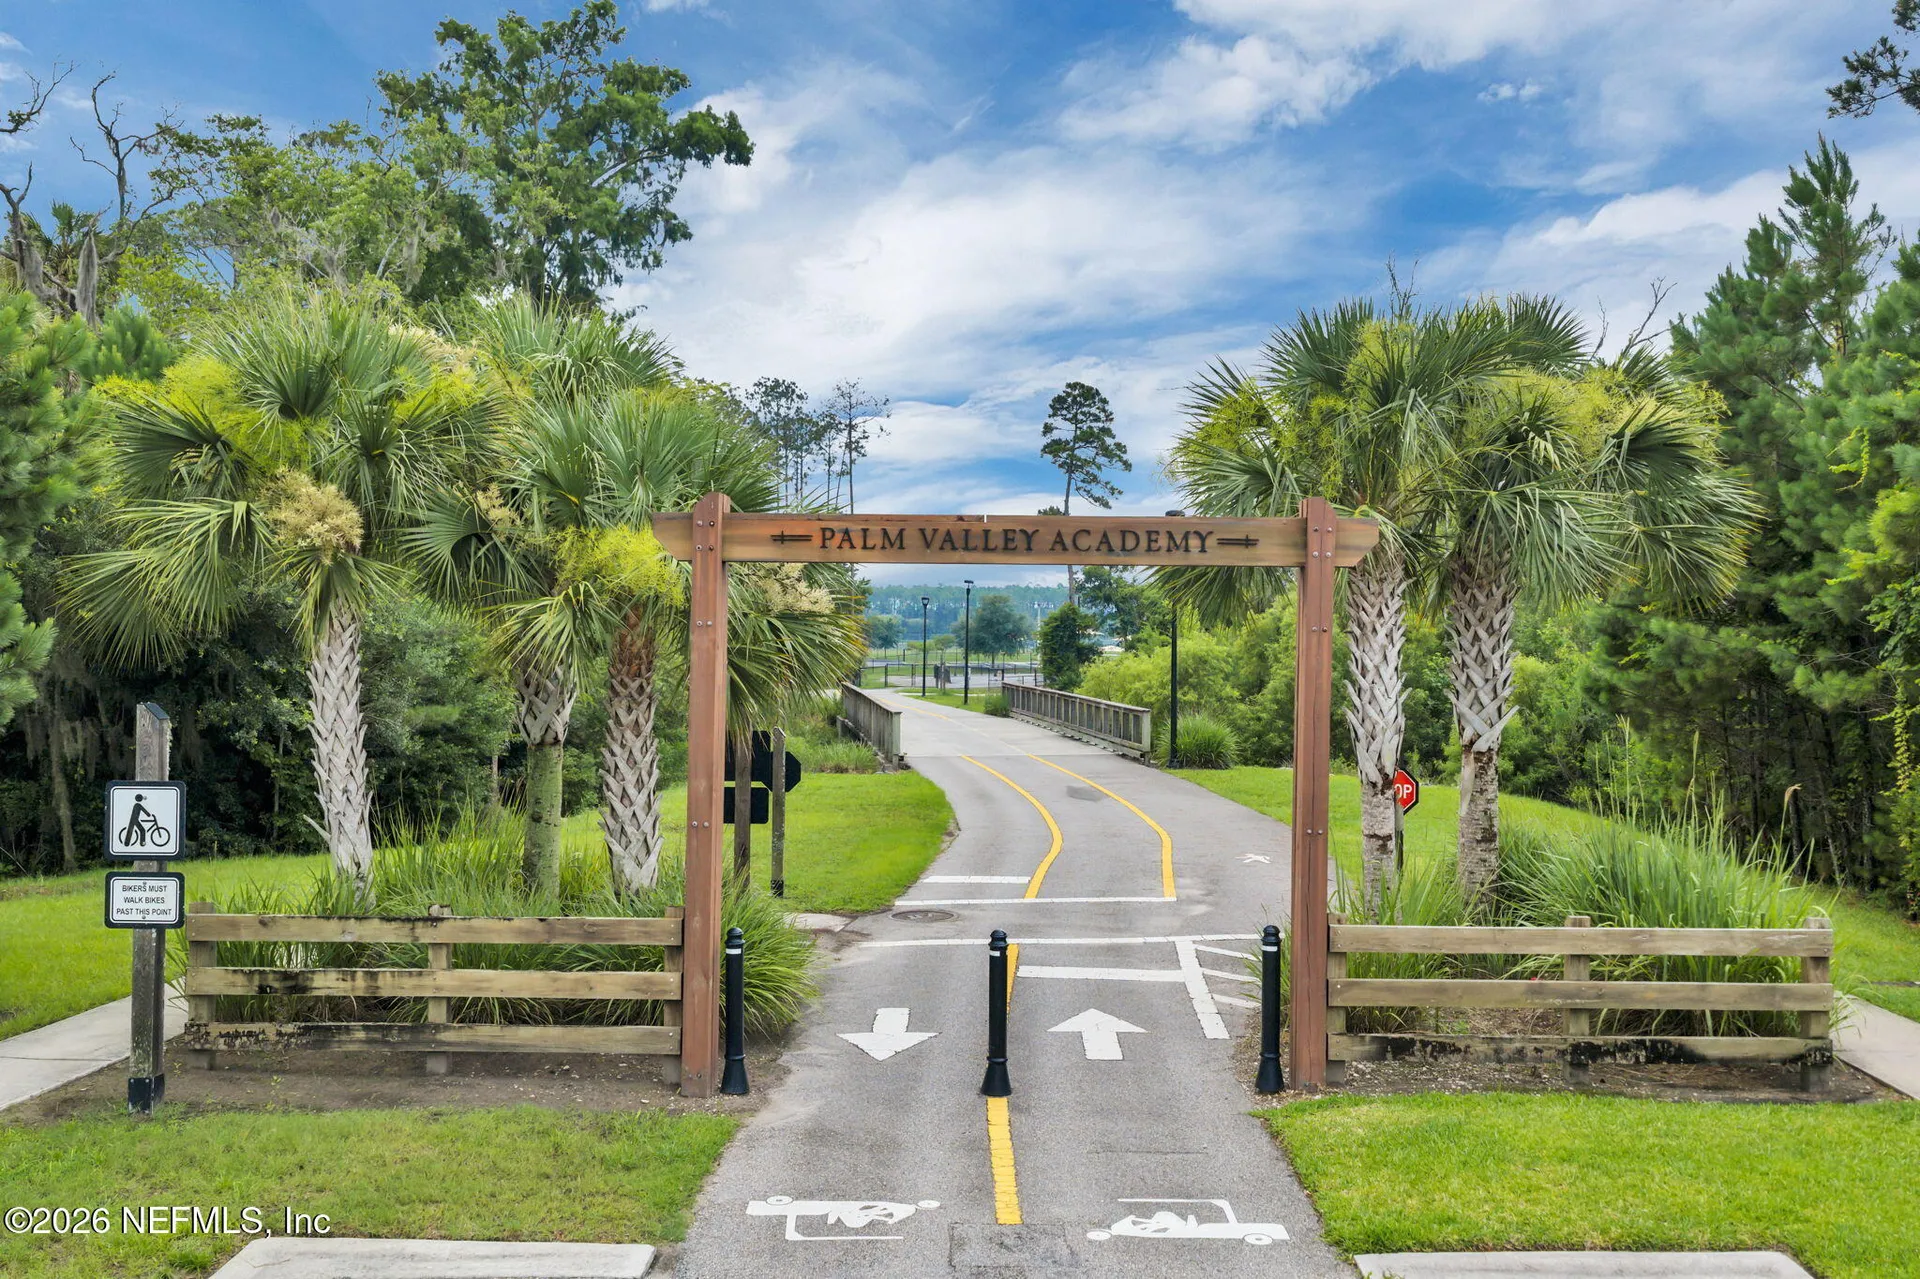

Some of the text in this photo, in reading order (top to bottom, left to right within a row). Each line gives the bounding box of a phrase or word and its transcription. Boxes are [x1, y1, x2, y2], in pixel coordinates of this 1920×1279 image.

[820, 527, 1214, 553] PALM VALLEY ACADEMY
[1394, 783, 1413, 799] OP
[151, 908, 172, 916] POINT
